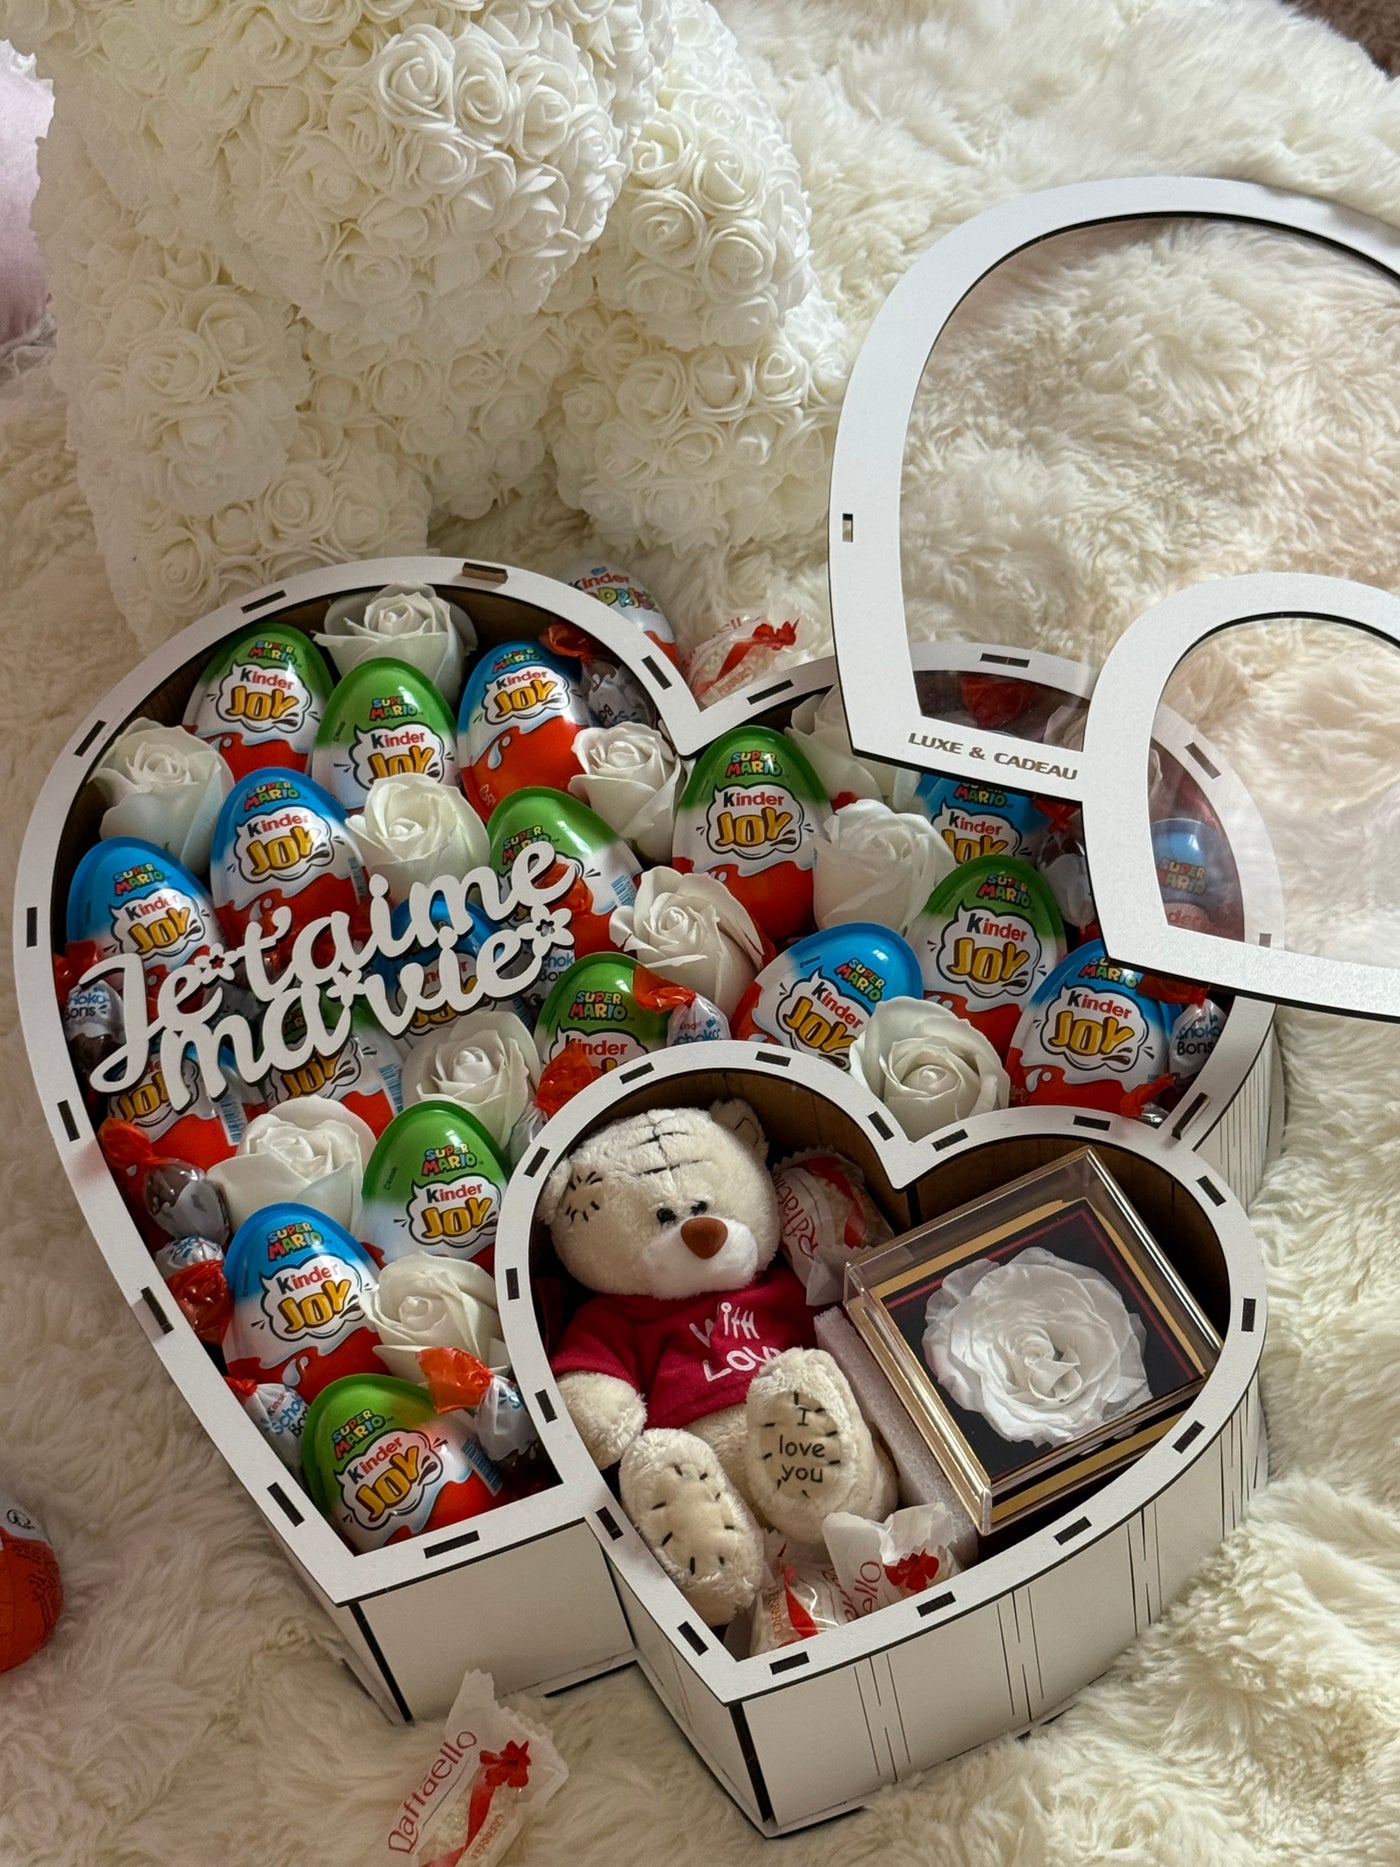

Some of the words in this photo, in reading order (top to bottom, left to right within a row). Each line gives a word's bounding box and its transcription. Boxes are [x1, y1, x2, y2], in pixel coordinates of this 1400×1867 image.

[248, 646, 296, 664] MARIO
[255, 640, 294, 654] SUPER
[240, 667, 294, 690] Kinder
[496, 671, 547, 690] Kinder
[225, 685, 299, 721] JOY
[493, 679, 557, 718] JOY
[369, 703, 417, 722] MARIO
[371, 731, 425, 749] Kinder
[725, 759, 782, 778] MARIO
[731, 750, 777, 762] SUPER
[908, 733, 964, 754] LUXE
[969, 746, 986, 760] &
[994, 752, 1078, 780] CADEAU
[243, 788, 300, 812] MARIO
[723, 791, 784, 808] Kinder
[953, 785, 1007, 808] MARIO
[247, 814, 308, 838] Kinder
[715, 806, 793, 847] JOY
[948, 811, 1002, 835] Kinder
[503, 825, 542, 849] SUPER
[246, 826, 321, 876] JOY
[114, 863, 154, 881] SUPER
[115, 870, 164, 896] MARIO
[987, 873, 1028, 893] SUPER
[976, 882, 1031, 909] MARIO
[127, 907, 190, 955] JOY
[966, 913, 1028, 942] Kinder
[946, 937, 1031, 984] JOY
[834, 963, 882, 1003] MARIO
[848, 957, 887, 991] SUPER
[1079, 964, 1138, 989] MARIO
[576, 990, 624, 1004] SUPER
[811, 981, 864, 1029] Kinder
[1067, 990, 1132, 1020] Kinder
[79, 953, 223, 1092] Je
[160, 980, 352, 1112] ma
[369, 925, 545, 1038] vie
[569, 1002, 628, 1021] MARIO
[782, 996, 857, 1053] JOY
[1048, 1011, 1135, 1056] JOY
[422, 1153, 477, 1176] MARIO
[424, 1143, 469, 1160] SUPER
[426, 1183, 482, 1203] Kinder
[421, 1197, 492, 1239] JOY
[267, 1222, 313, 1242] SUPER
[268, 1231, 324, 1262] MARIO
[276, 1264, 338, 1295] Kinder
[277, 1279, 351, 1334] JOY
[331, 1409, 375, 1443] SUPER
[797, 1408, 811, 1427] I
[334, 1414, 387, 1461] MARIO
[779, 1434, 826, 1457] love
[347, 1437, 403, 1485] Kinder
[781, 1464, 823, 1483] you
[355, 1446, 420, 1523] JOY
[388, 1731, 478, 1854] Raffaello
